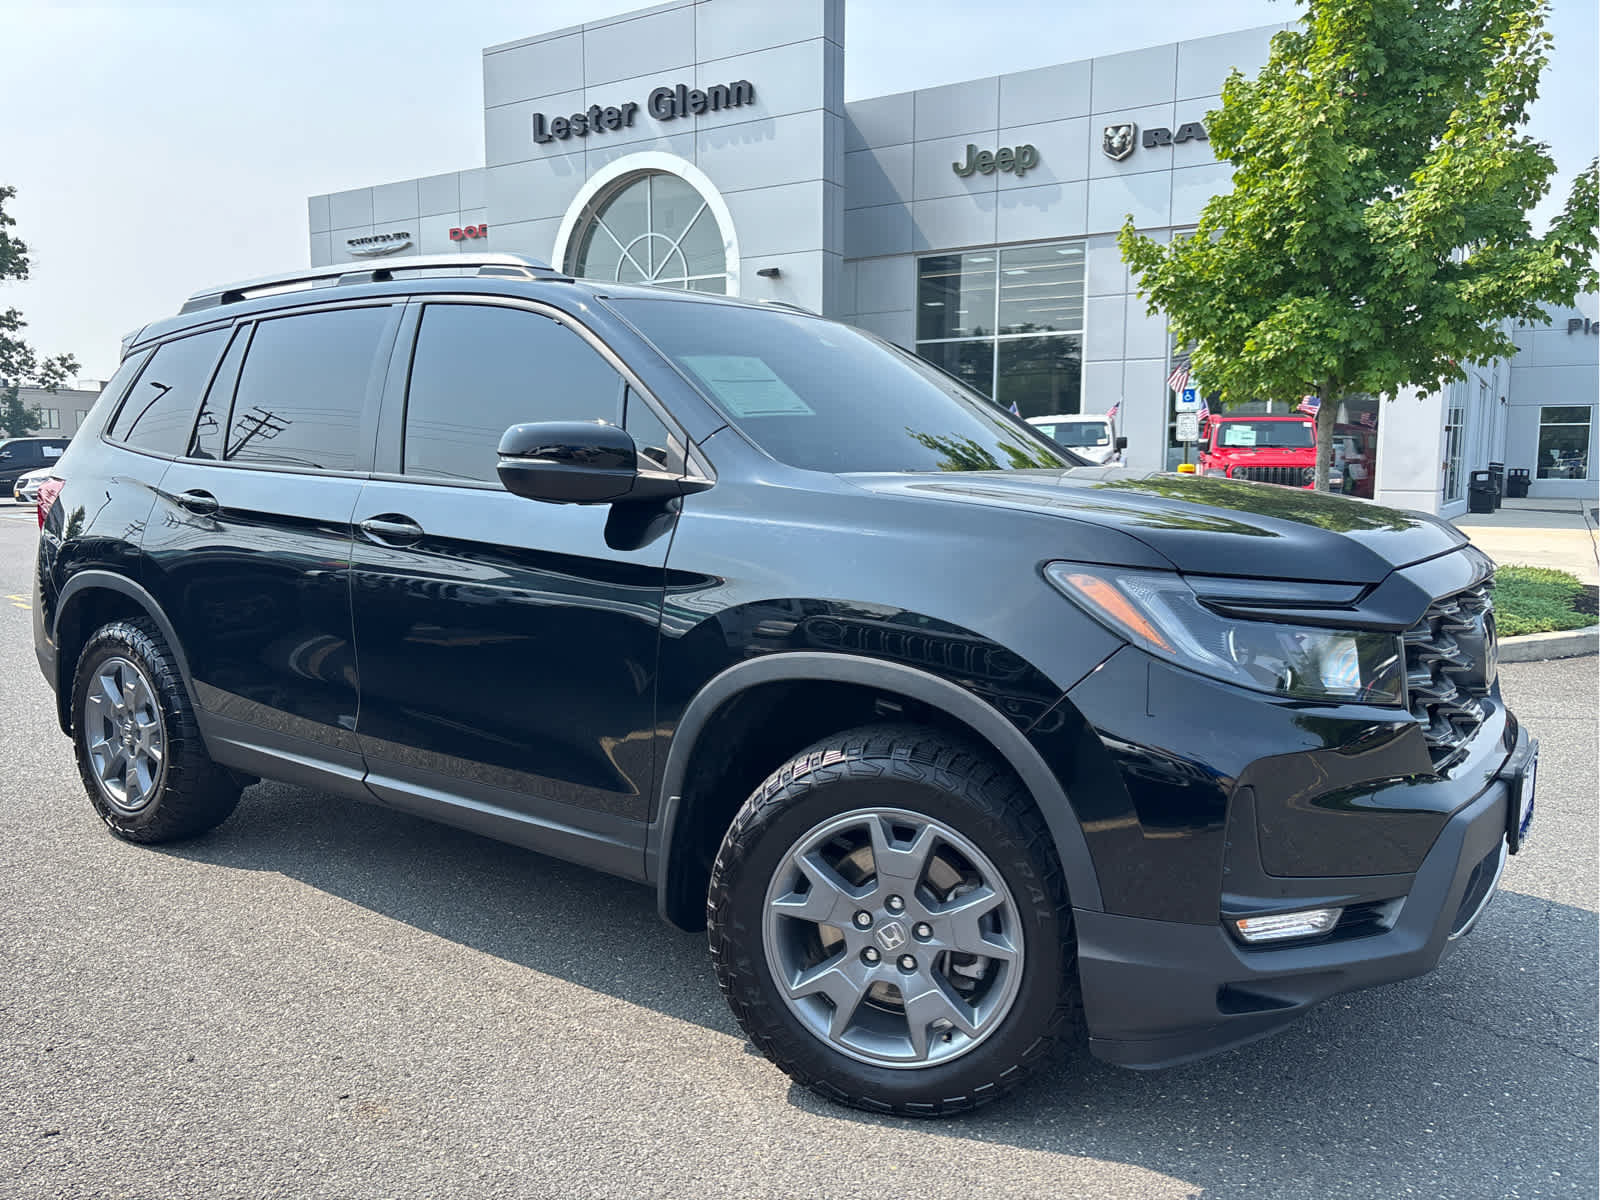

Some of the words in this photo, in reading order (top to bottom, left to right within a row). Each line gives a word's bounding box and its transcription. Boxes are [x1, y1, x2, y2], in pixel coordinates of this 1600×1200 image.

[532, 101, 639, 144] Lester
[647, 79, 754, 121] Glenn
[1142, 122, 1208, 148] RA
[952, 143, 1040, 178] Jeep
[449, 223, 488, 241] DOD
